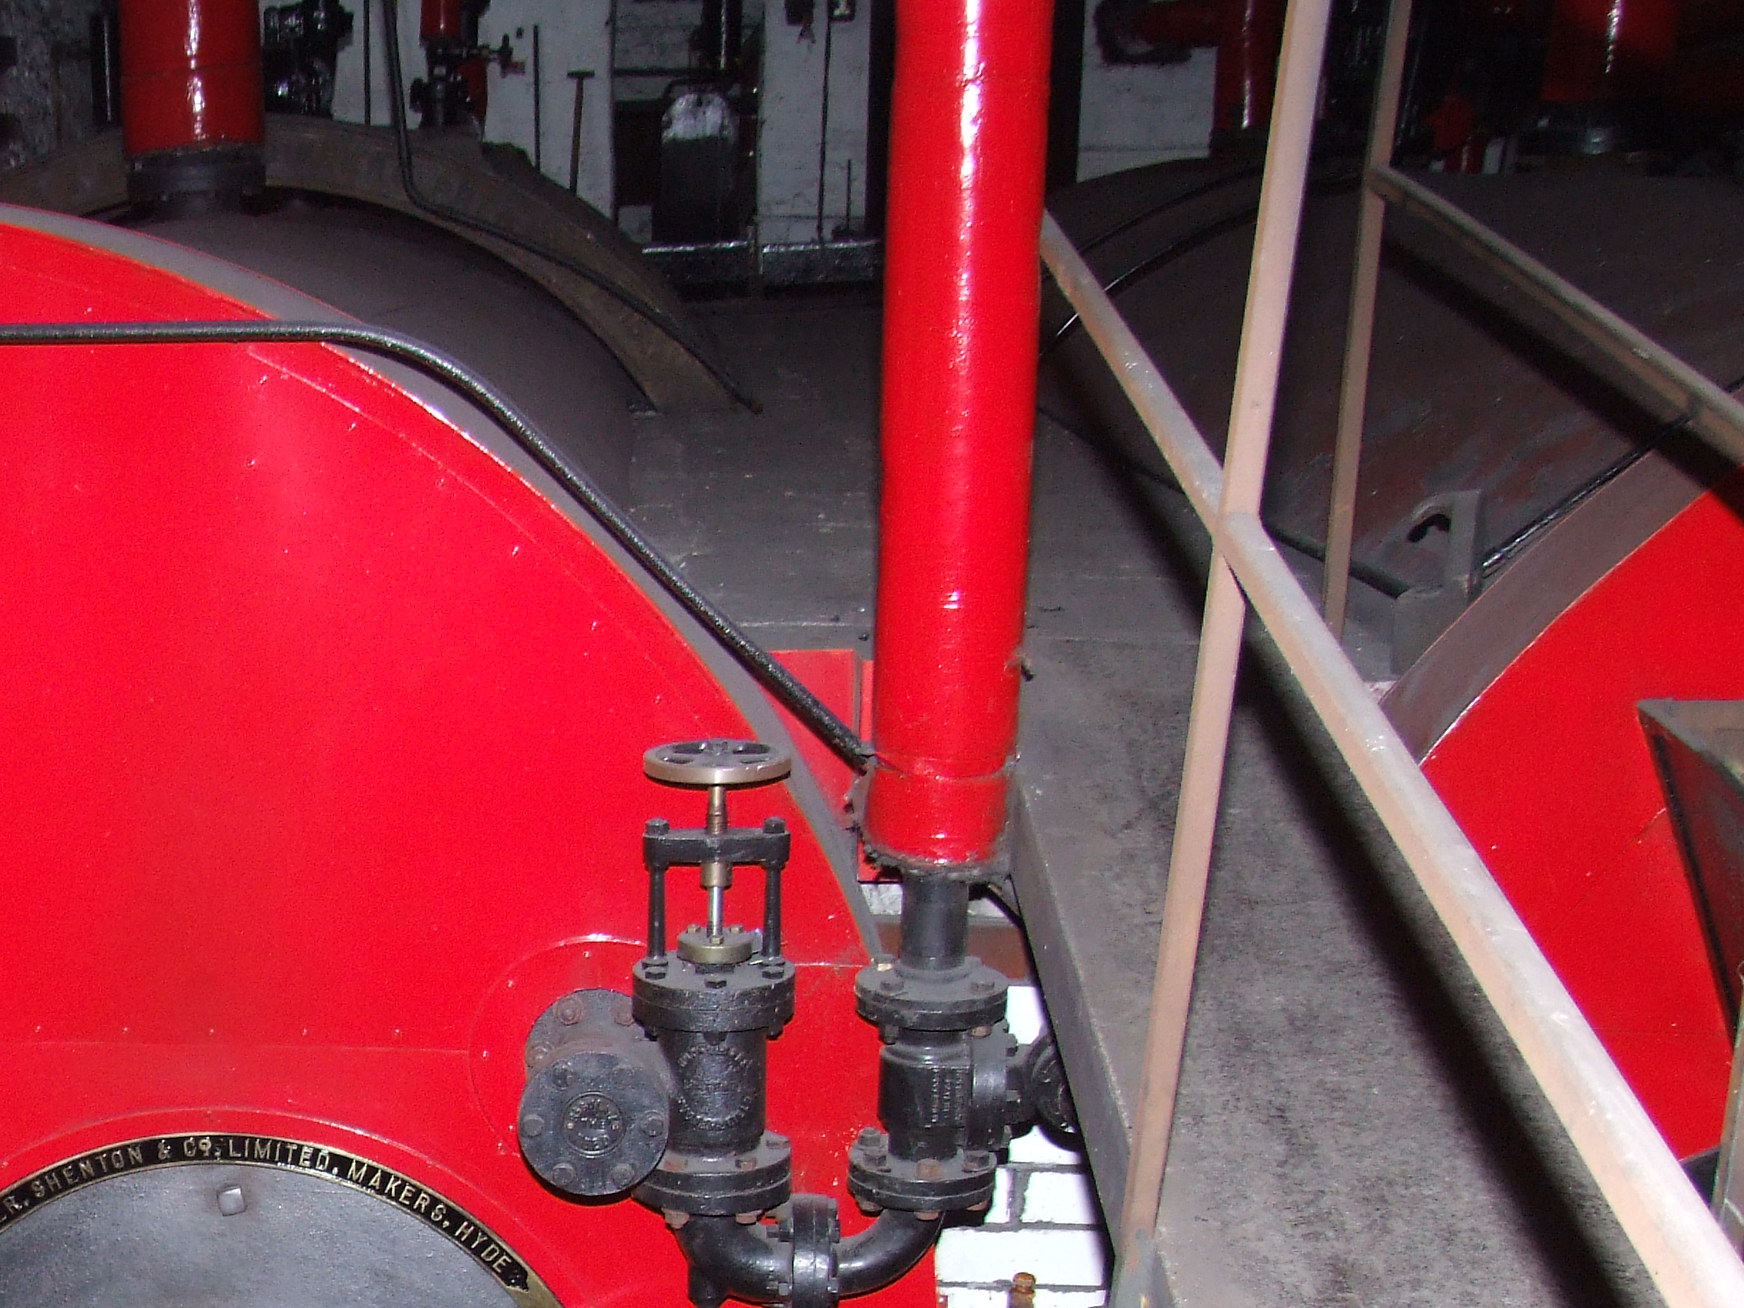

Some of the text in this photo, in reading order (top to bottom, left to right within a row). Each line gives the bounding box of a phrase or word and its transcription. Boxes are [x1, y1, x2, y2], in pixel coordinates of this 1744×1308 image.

[30, 1146, 144, 1199] SHENTON
[157, 1138, 172, 1160] &
[455, 1221, 512, 1273] HYDE
